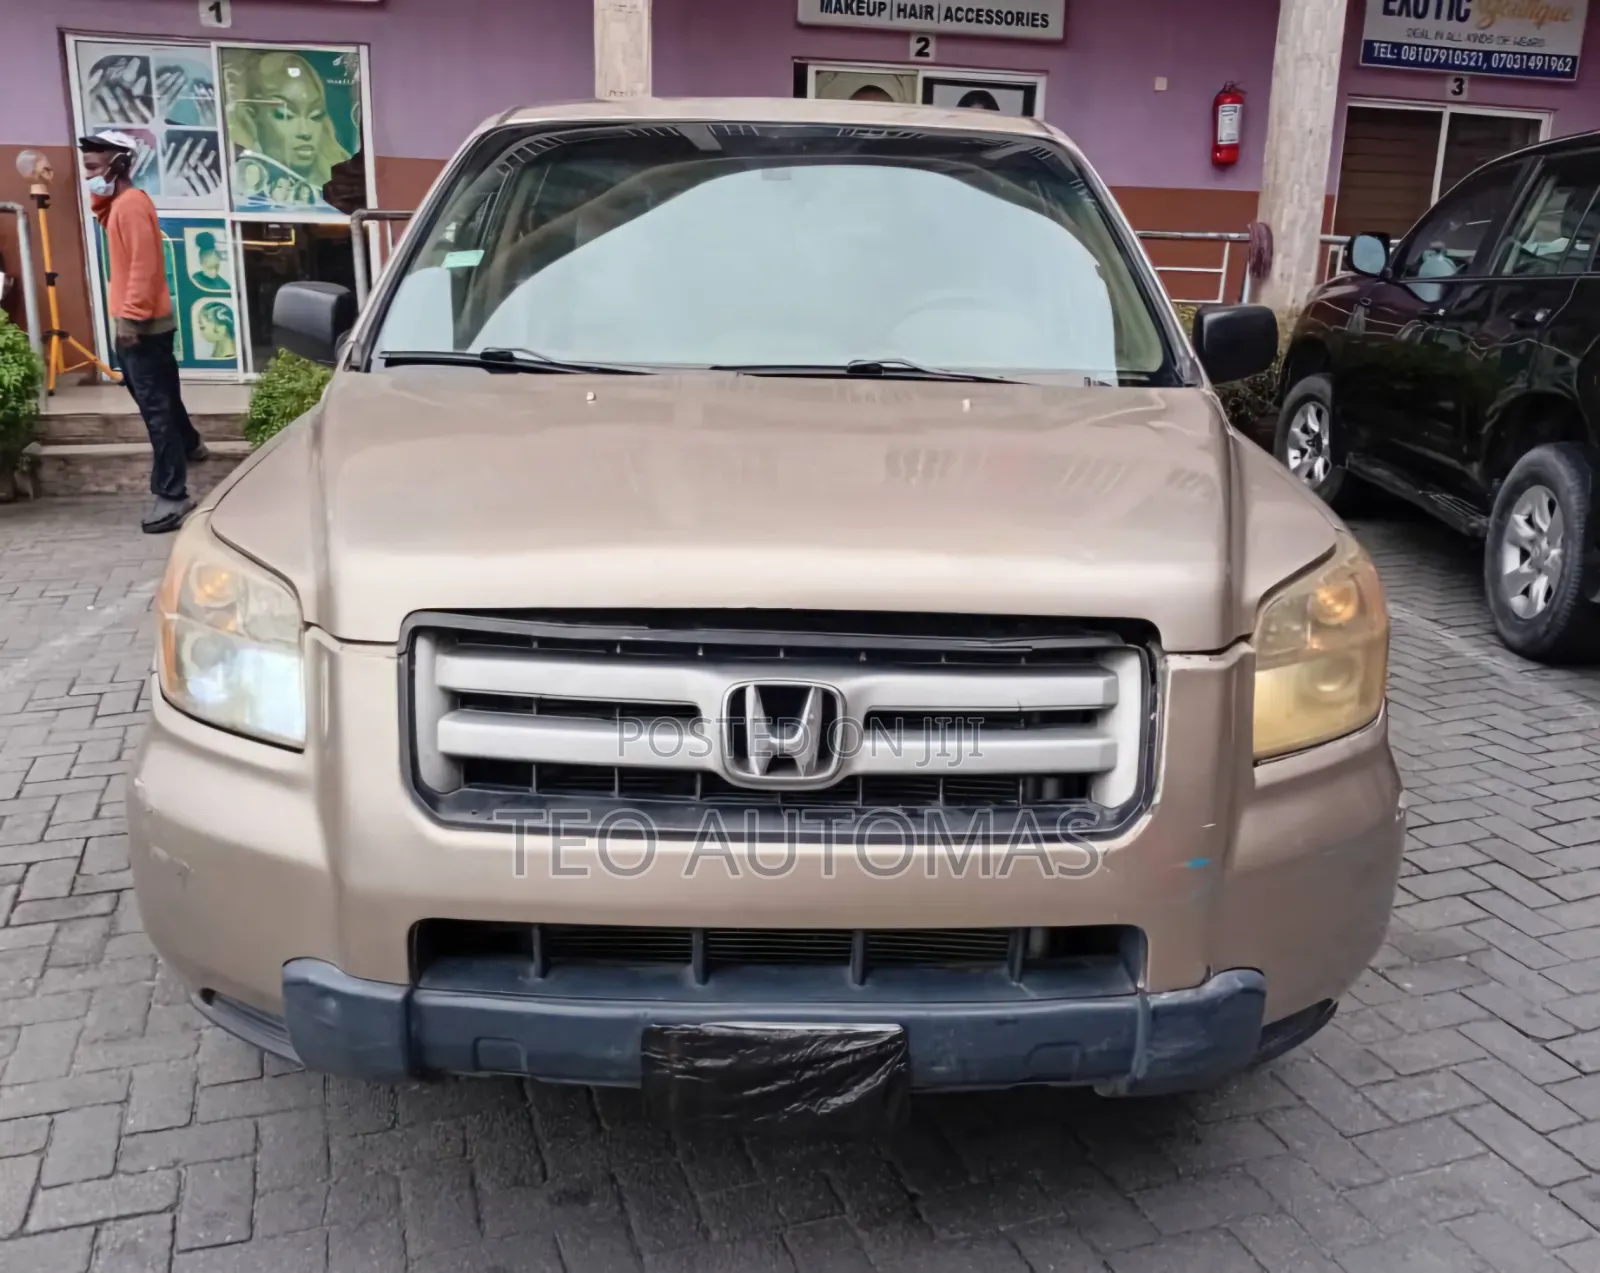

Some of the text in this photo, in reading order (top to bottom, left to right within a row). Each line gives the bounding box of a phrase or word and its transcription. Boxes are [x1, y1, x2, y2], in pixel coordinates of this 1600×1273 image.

[208, 1, 223, 24] 1
[820, 0, 1049, 28] MAKEUP HAIR ACCESSORIES
[914, 37, 931, 58] 2
[1373, 42, 1572, 72] TEL: 08107910521, 07031491962
[1451, 77, 1465, 96] 3
